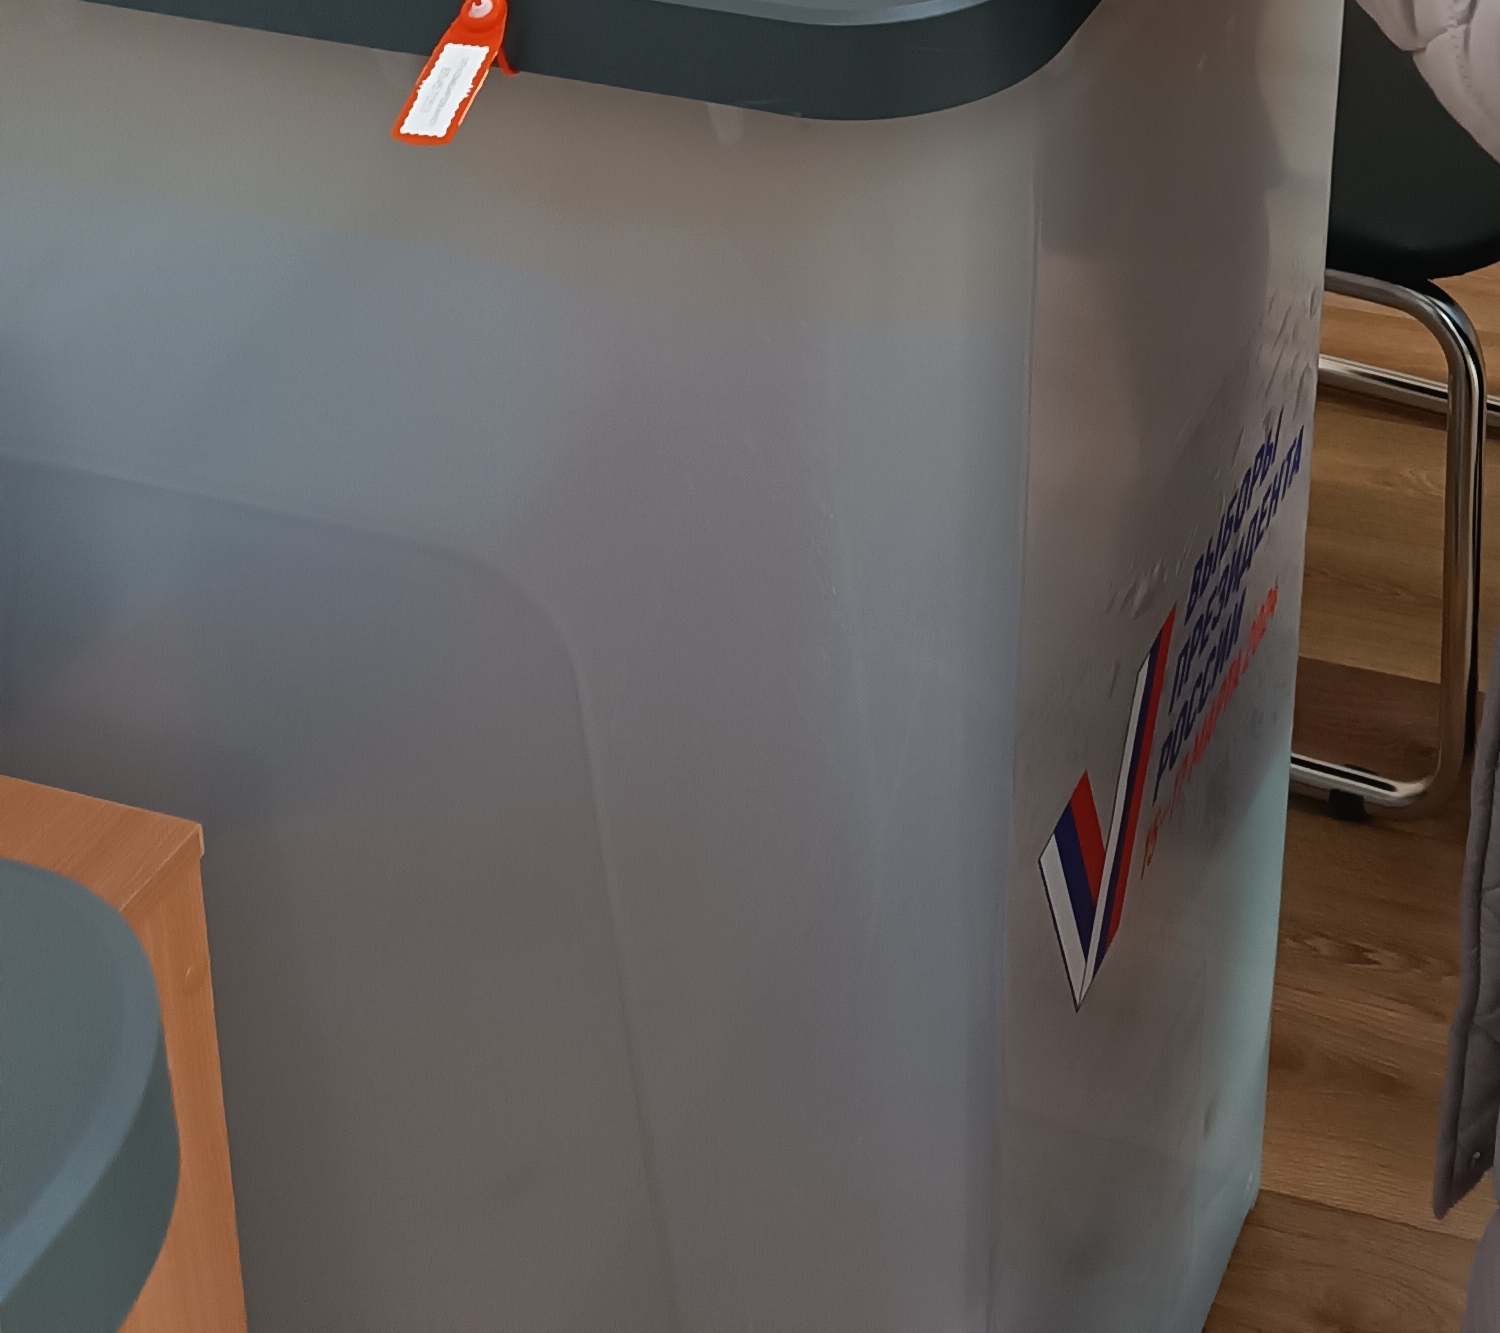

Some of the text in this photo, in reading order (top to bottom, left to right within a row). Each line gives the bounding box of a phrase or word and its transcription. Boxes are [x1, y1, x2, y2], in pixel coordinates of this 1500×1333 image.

[1168, 424, 1305, 717] ПРЕЗИДЕНТА
[1183, 405, 1284, 627] ВЫБОРЫ
[1152, 585, 1247, 808] РОССИИ
